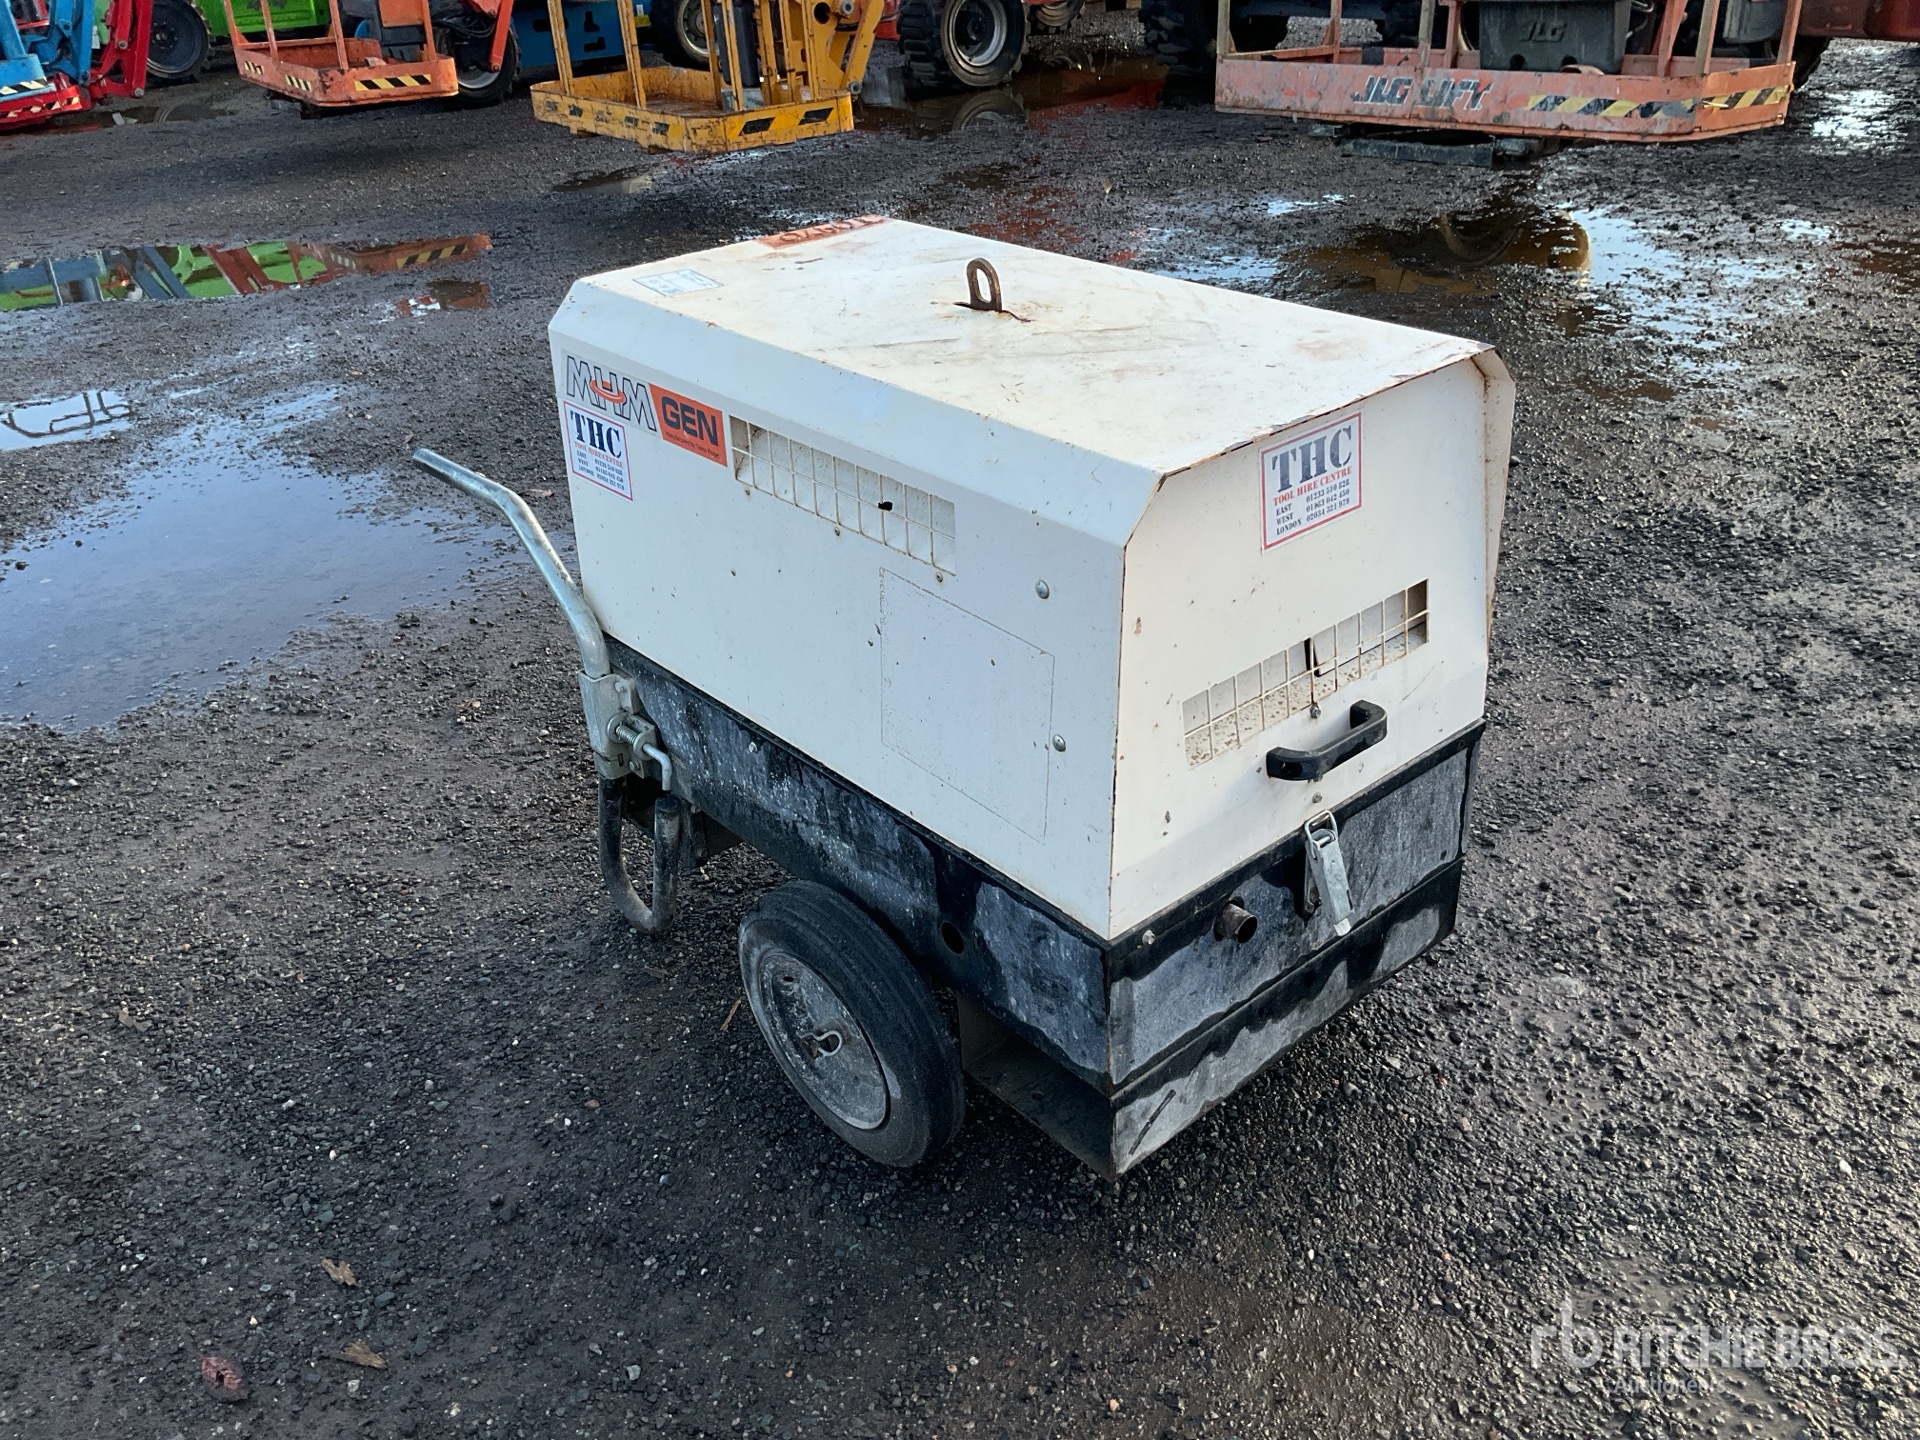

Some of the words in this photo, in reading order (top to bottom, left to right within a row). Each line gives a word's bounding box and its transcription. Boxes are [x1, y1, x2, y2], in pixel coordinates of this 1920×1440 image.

[1521, 20, 1567, 42] JLG
[1351, 76, 1413, 106] JLG
[1415, 77, 1493, 110] LIFT
[567, 355, 657, 432] MHM
[662, 396, 719, 447] GEN
[570, 410, 622, 459] THC
[1272, 425, 1352, 493] THC
[1273, 490, 1295, 506] TOOL
[1297, 480, 1319, 496] HIRE
[1320, 466, 1352, 486] CENTRE
[1276, 502, 1292, 516] EAST
[1306, 488, 1325, 503] 01233
[1326, 483, 1338, 494] 510
[1276, 511, 1294, 525] WEST
[1338, 488, 1350, 499] 450
[1276, 517, 1302, 535] LONDON
[1306, 507, 1325, 522] 02034
